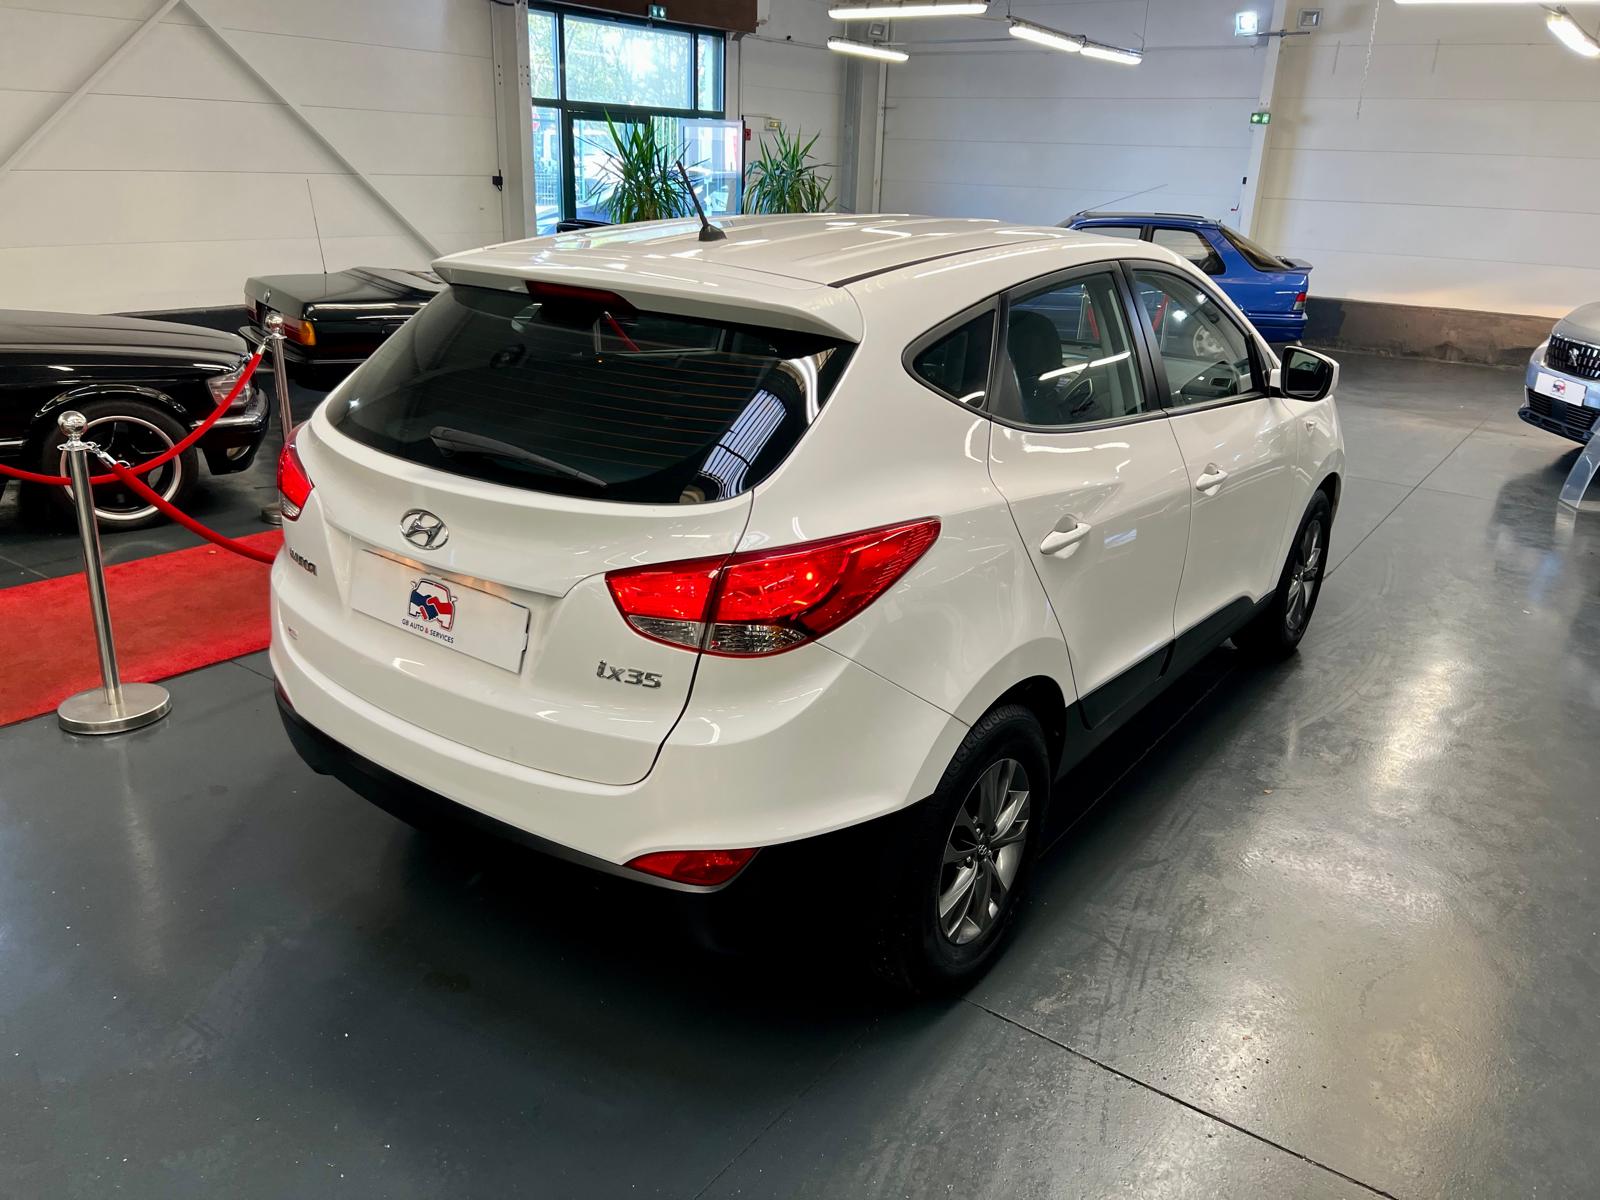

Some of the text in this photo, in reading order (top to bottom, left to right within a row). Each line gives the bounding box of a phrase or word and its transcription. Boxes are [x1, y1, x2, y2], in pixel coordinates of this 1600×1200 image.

[410, 622, 424, 632] AUTO
[430, 629, 454, 644] SERVICES
[596, 659, 663, 689] ix35
